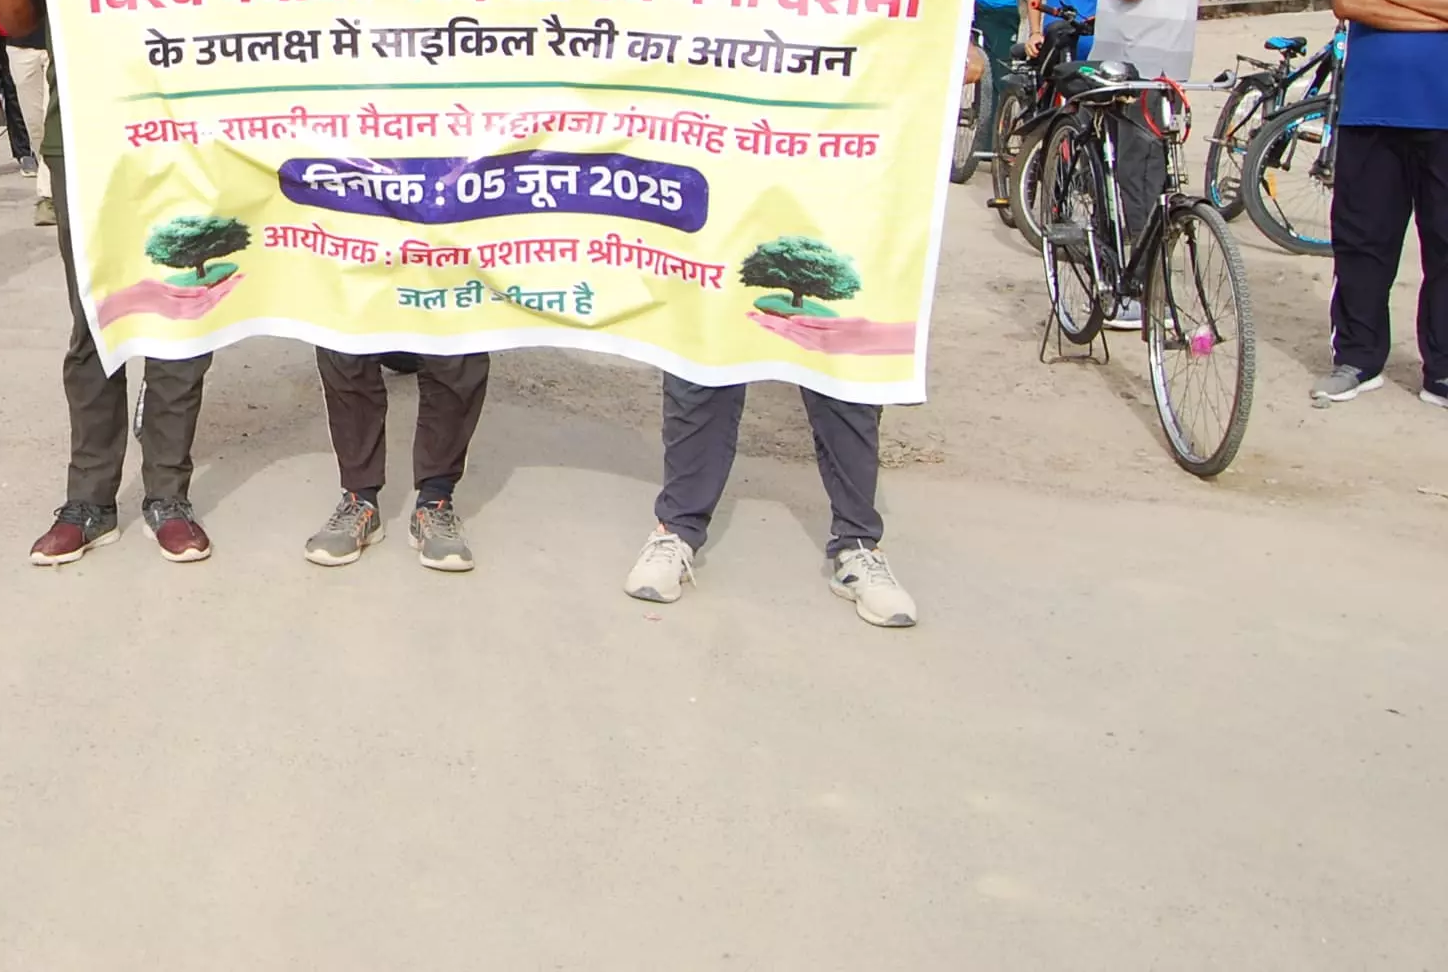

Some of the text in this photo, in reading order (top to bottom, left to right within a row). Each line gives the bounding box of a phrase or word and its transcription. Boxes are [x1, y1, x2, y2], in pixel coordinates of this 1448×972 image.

[145, 14, 858, 77] के उपलक्ष में साइकिल रैली का आयोजन
[359, 102, 439, 141] मैदान
[445, 103, 475, 137] से
[613, 107, 728, 154] गंगासिंह
[734, 118, 812, 157] चौक
[817, 133, 880, 158] तक
[457, 168, 506, 205] 05
[514, 164, 581, 209] जून
[589, 166, 683, 212] 2025
[263, 222, 379, 264] आयोजक
[399, 239, 471, 268] जिला
[478, 236, 580, 270] प्रशासन
[586, 232, 728, 290] श्रीगंगानगर
[396, 286, 449, 310] जल
[452, 279, 485, 309] ही
[572, 281, 595, 315] है
